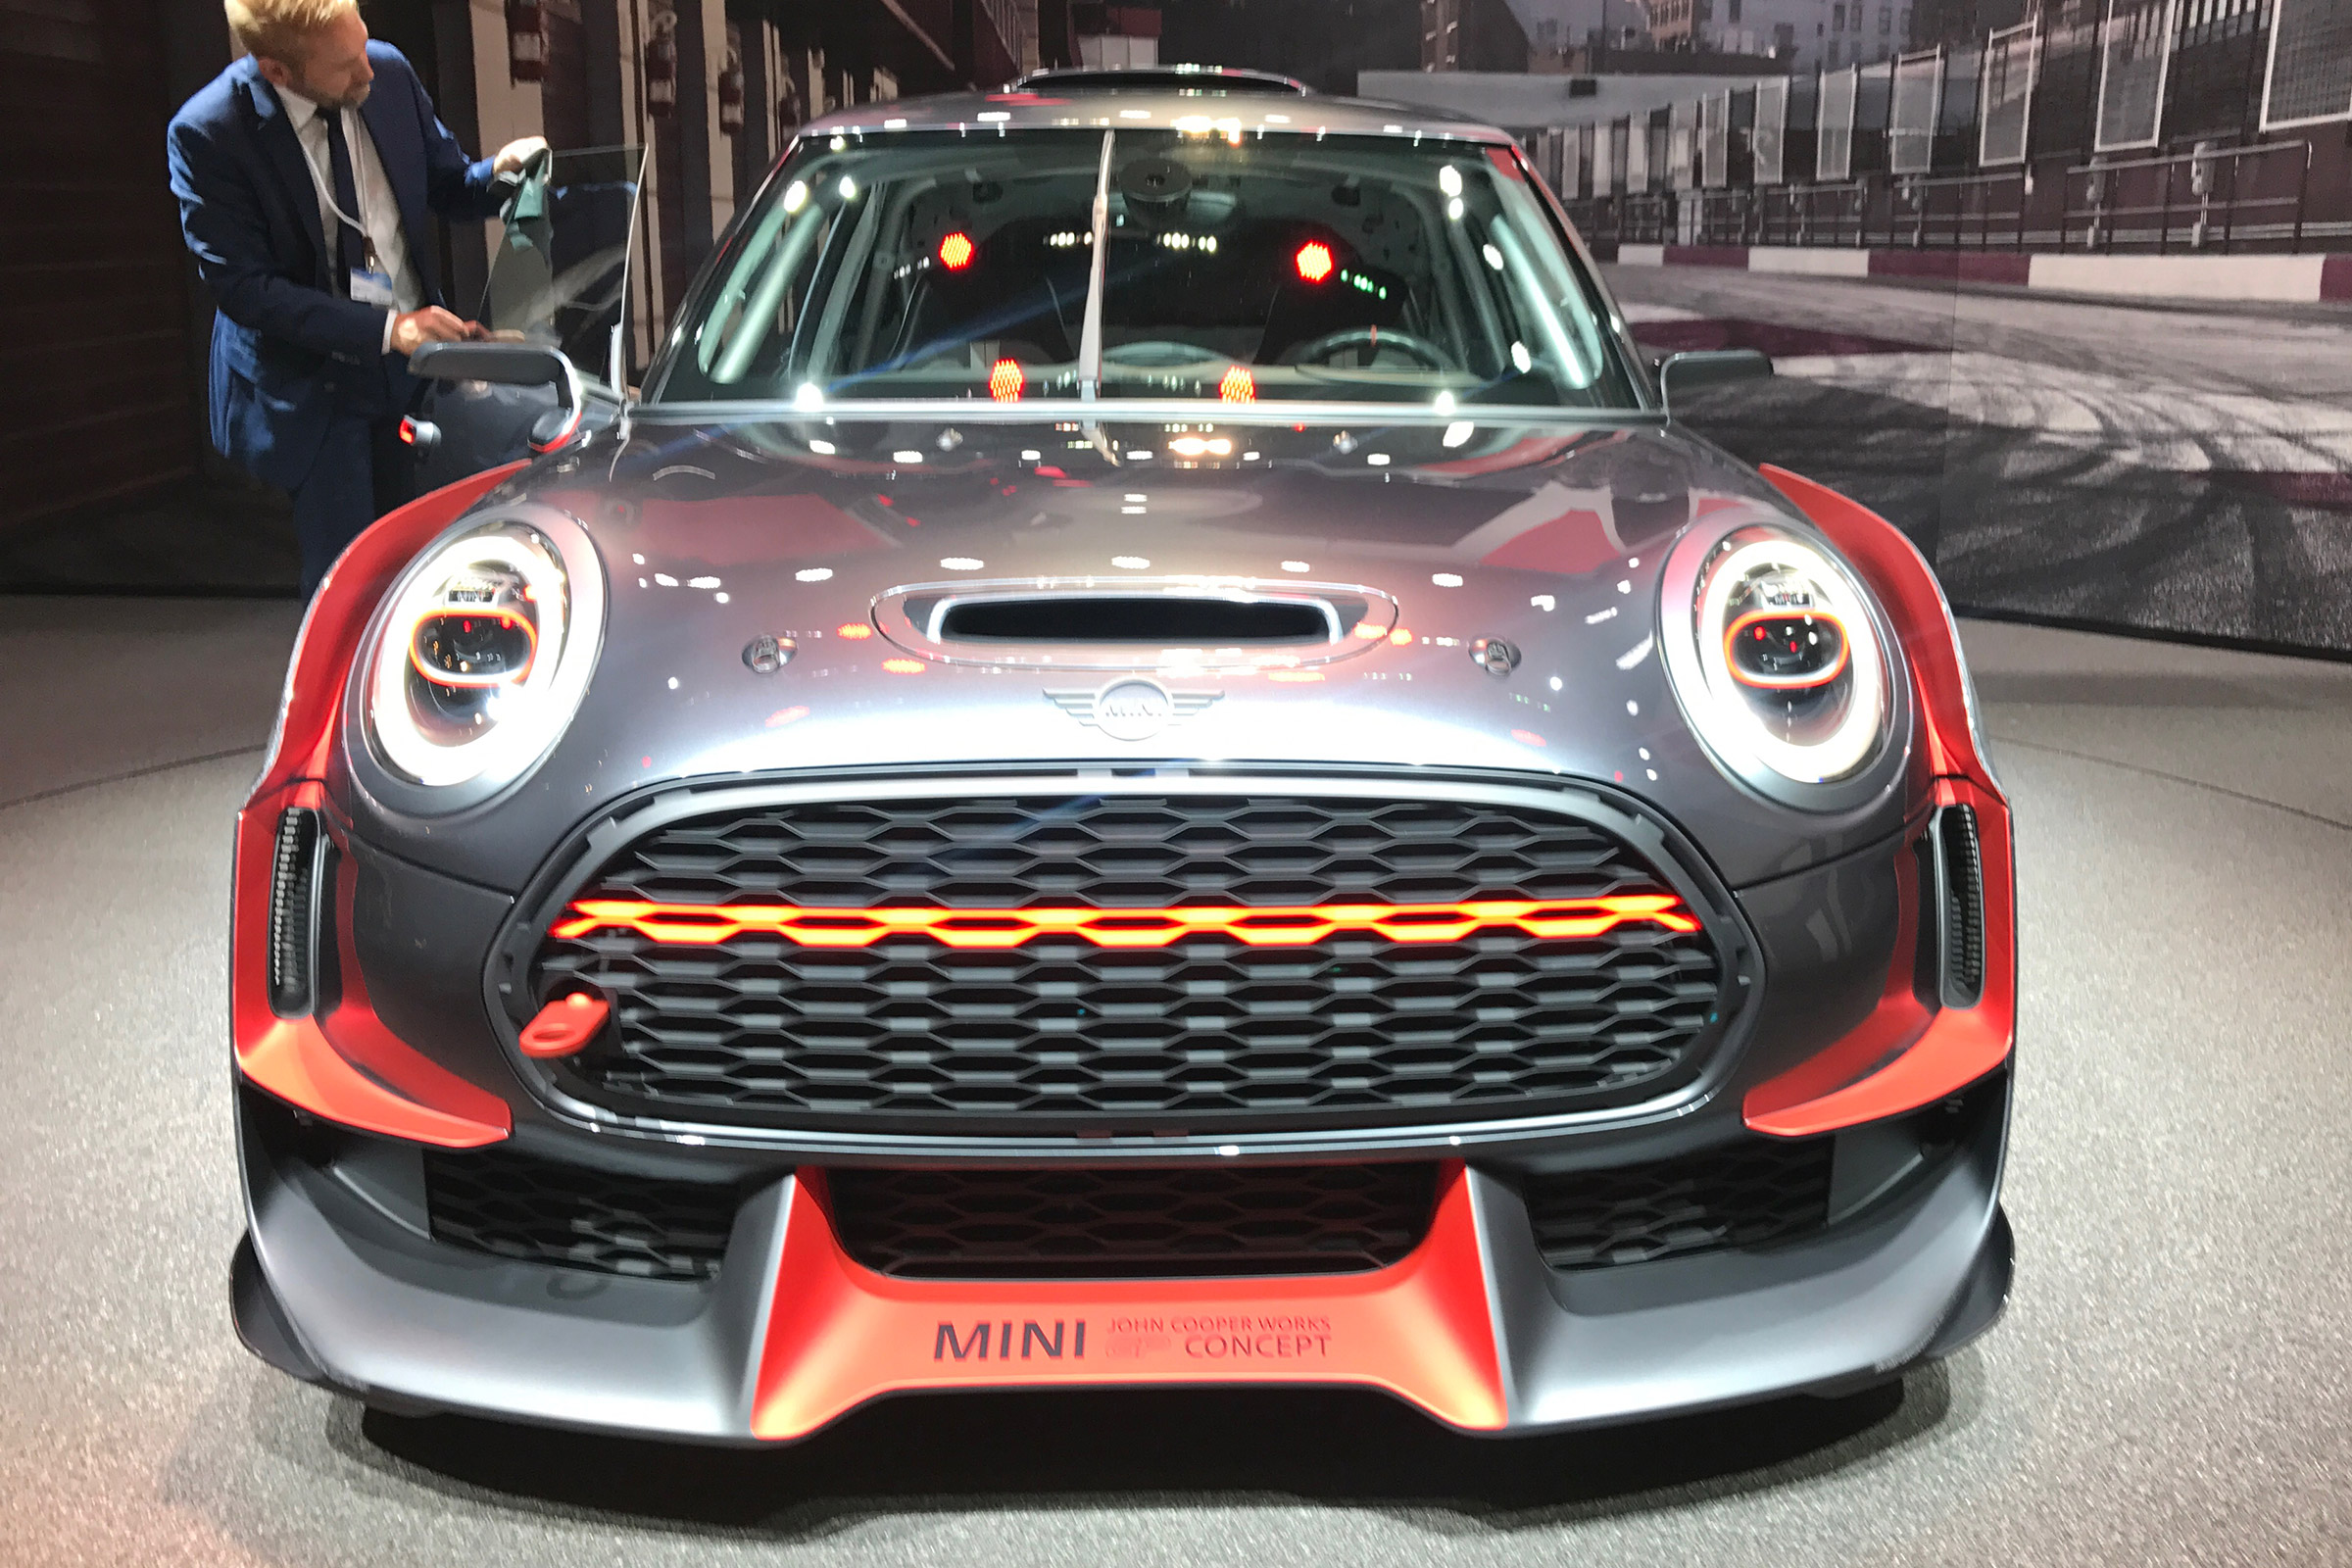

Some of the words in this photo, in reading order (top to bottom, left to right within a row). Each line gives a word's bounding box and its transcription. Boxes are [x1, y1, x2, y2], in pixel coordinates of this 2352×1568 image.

[1106, 1316, 1165, 1334] JOHN
[1170, 1316, 1253, 1334] COOPER
[1255, 1316, 1332, 1332] WORKS
[934, 1320, 1086, 1360] MINI
[1185, 1334, 1332, 1358] CONCEPT
